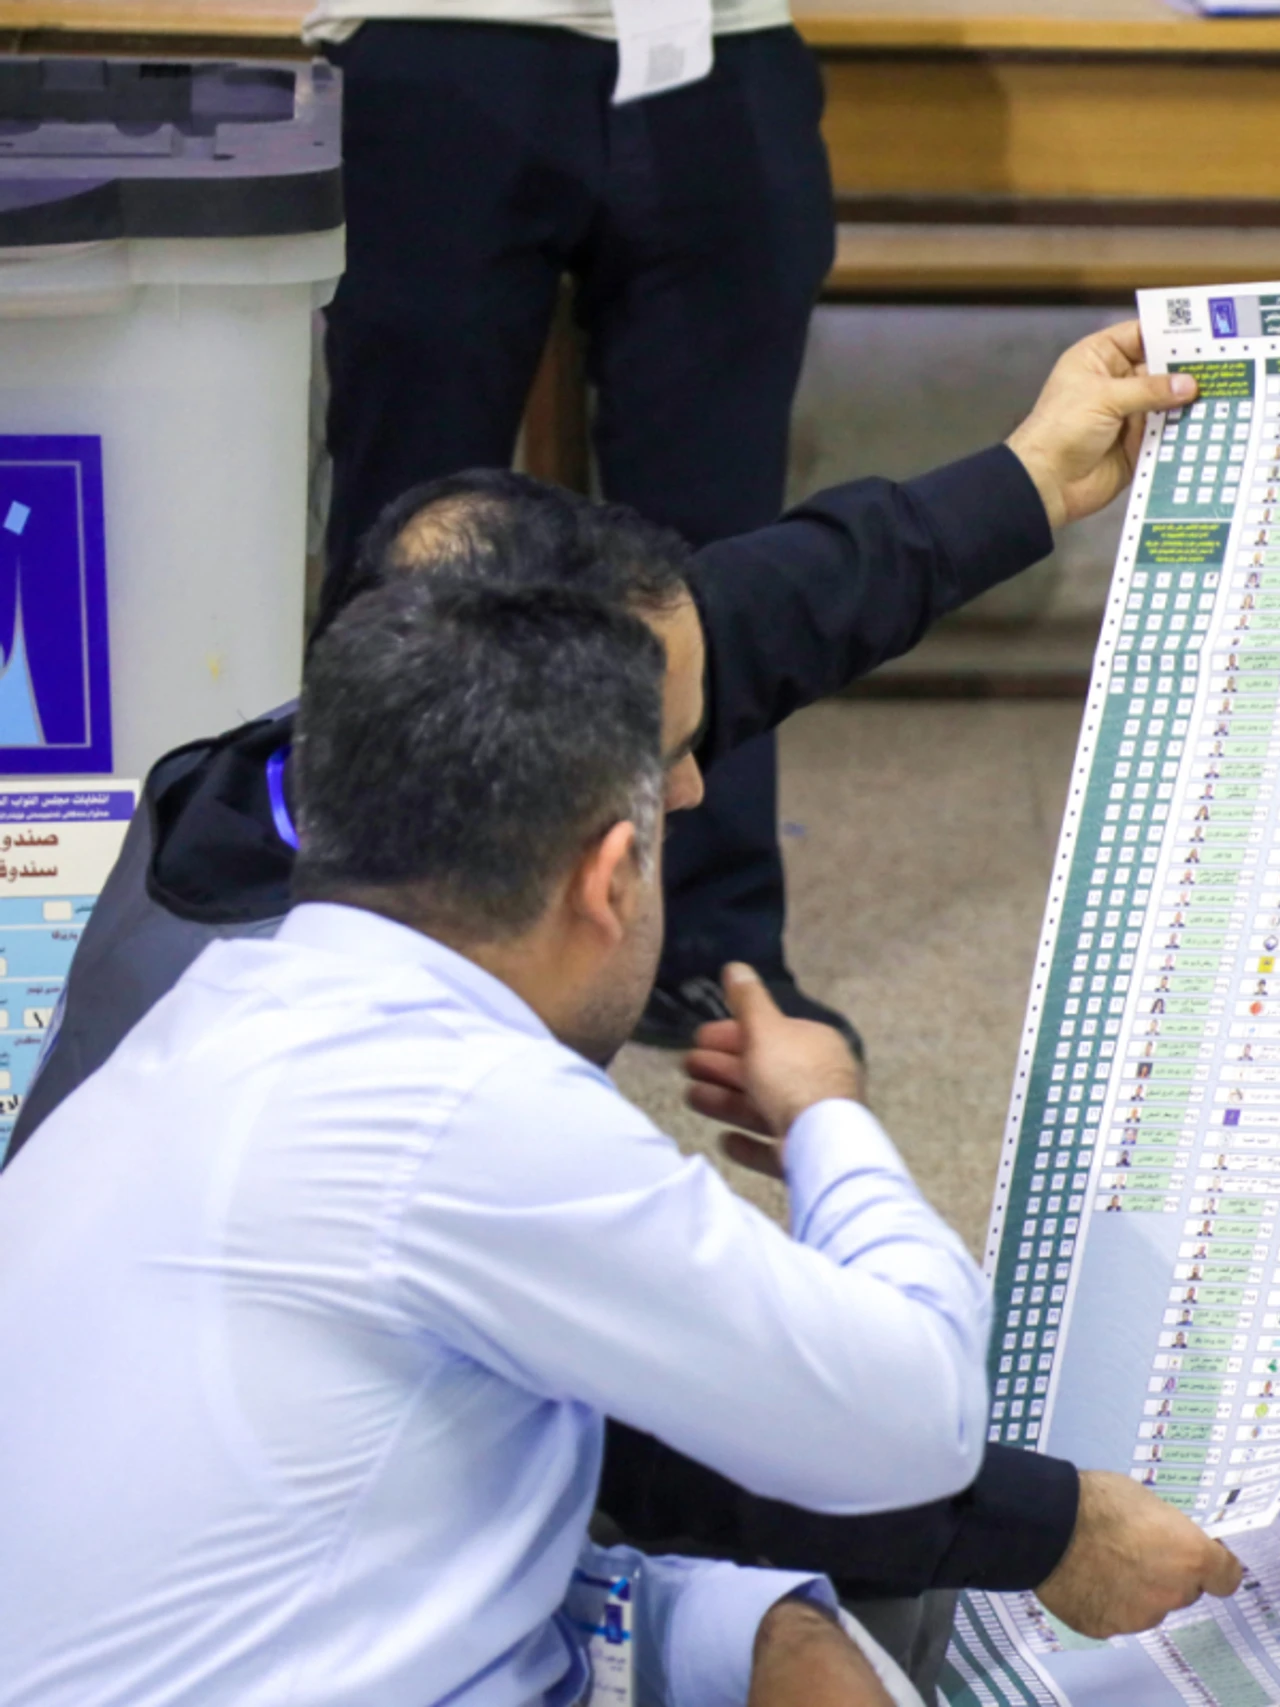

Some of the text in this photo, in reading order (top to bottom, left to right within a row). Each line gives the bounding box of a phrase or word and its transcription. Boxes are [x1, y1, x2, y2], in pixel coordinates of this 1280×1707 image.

[11, 795, 39, 808] النواب
[41, 795, 70, 808] مجلس
[72, 793, 110, 807] انتخابات
